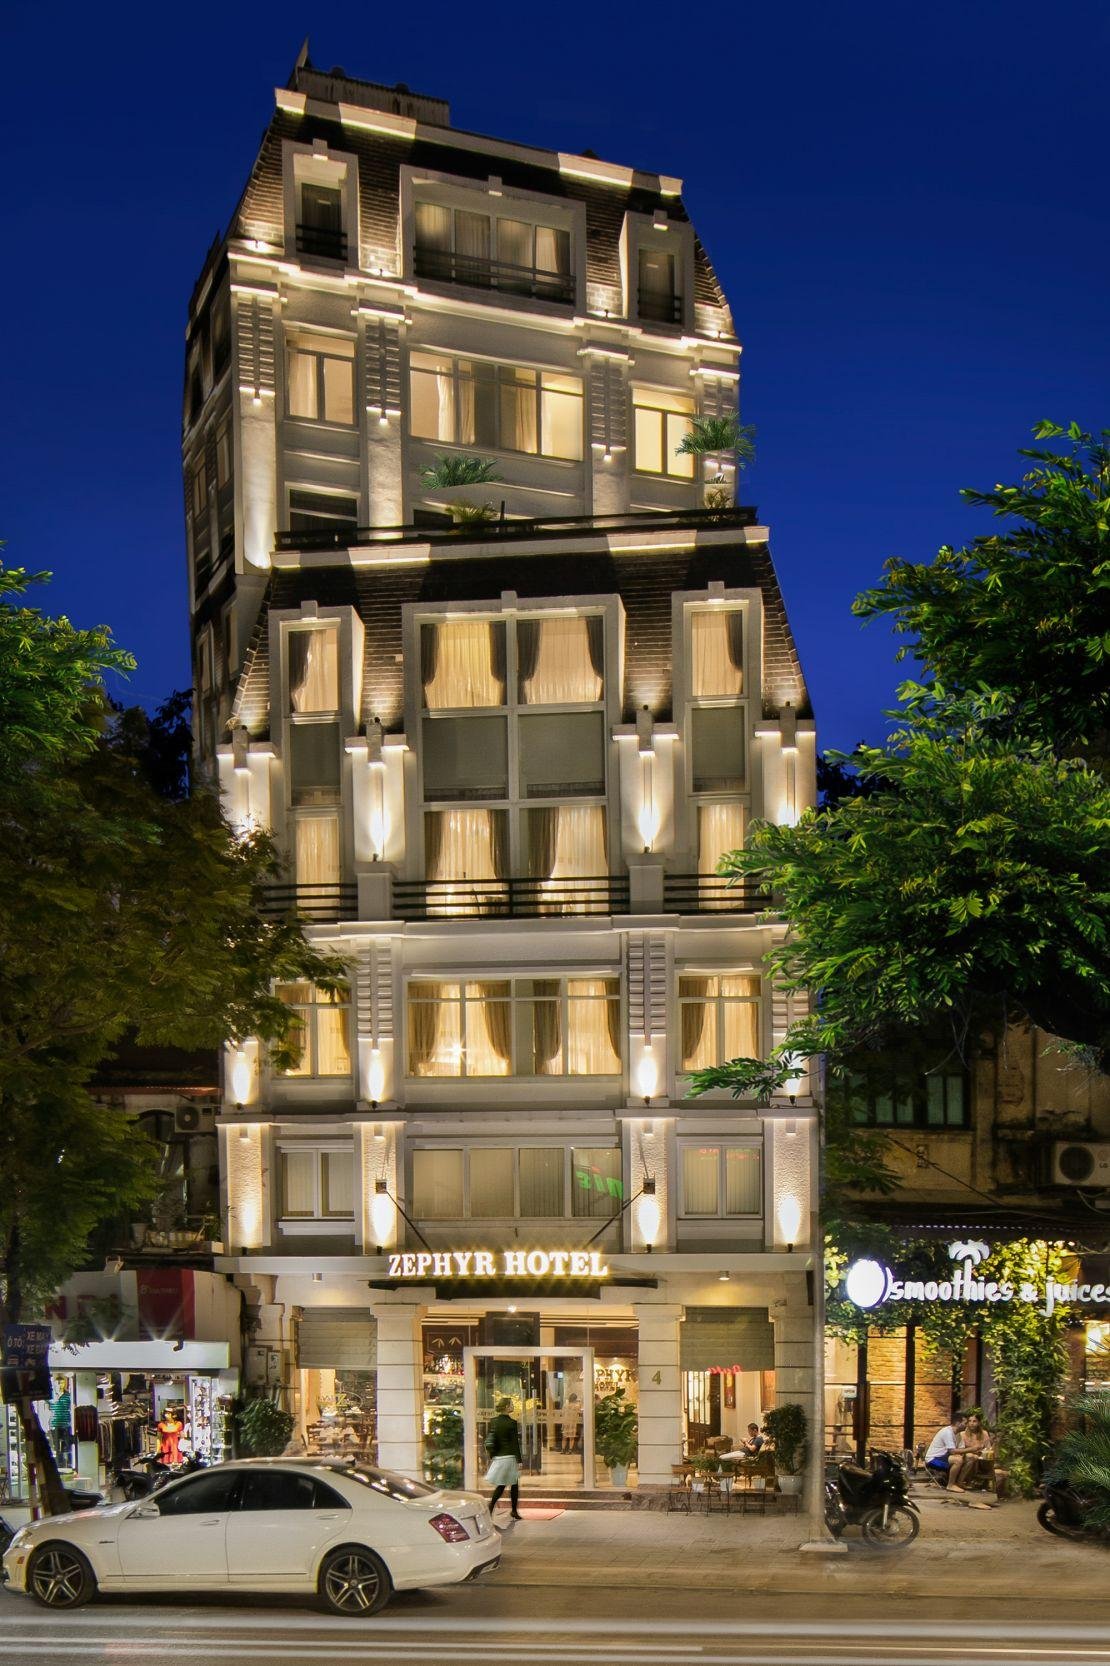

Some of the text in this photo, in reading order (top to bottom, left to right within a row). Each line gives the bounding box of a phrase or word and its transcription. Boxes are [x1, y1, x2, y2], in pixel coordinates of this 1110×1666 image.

[388, 1251, 609, 1277] ZEPHYR HOTEL
[889, 1260, 1014, 1302] smoothies
[1019, 1282, 1040, 1303] &
[651, 1369, 662, 1385] 4
